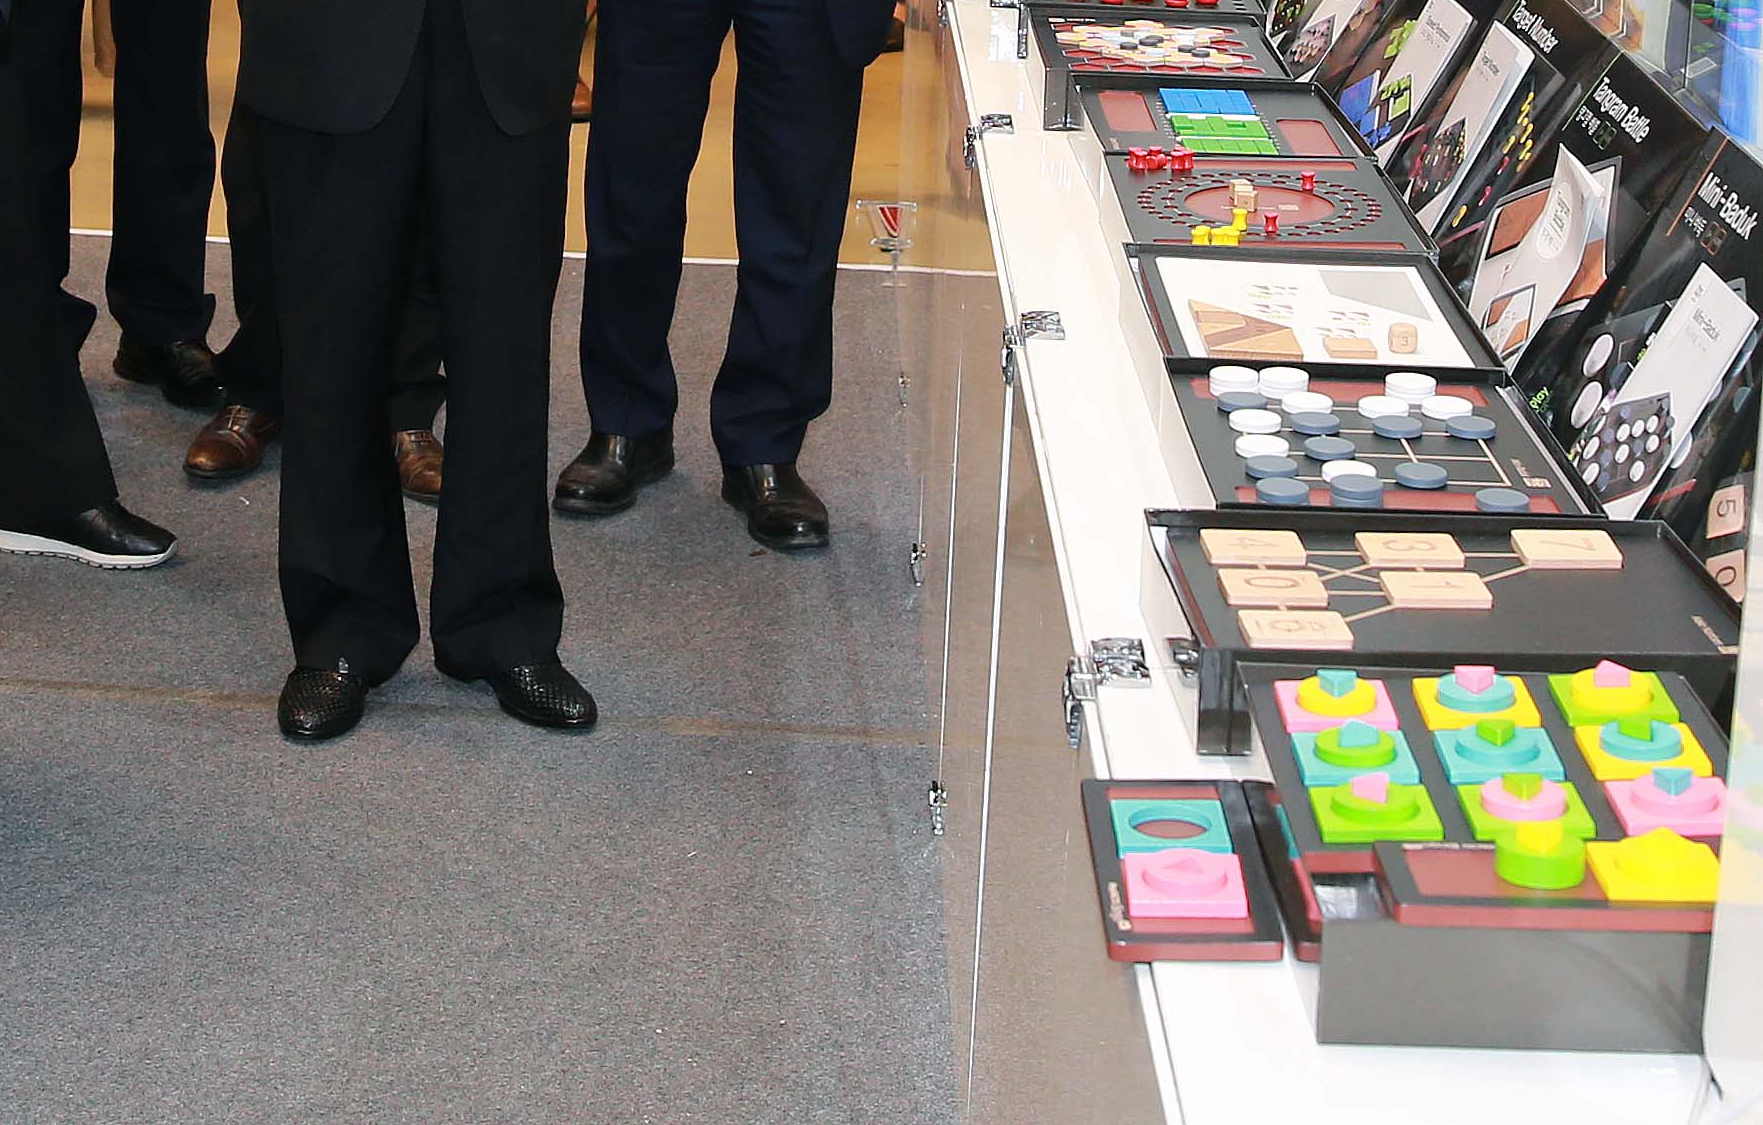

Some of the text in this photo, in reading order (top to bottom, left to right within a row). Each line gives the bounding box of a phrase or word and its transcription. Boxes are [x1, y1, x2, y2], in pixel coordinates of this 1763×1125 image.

[1512, 0, 1560, 54] Target Number
[1593, 76, 1652, 143] Tangram Battle
[1697, 171, 1758, 241] Mini-Baduk
